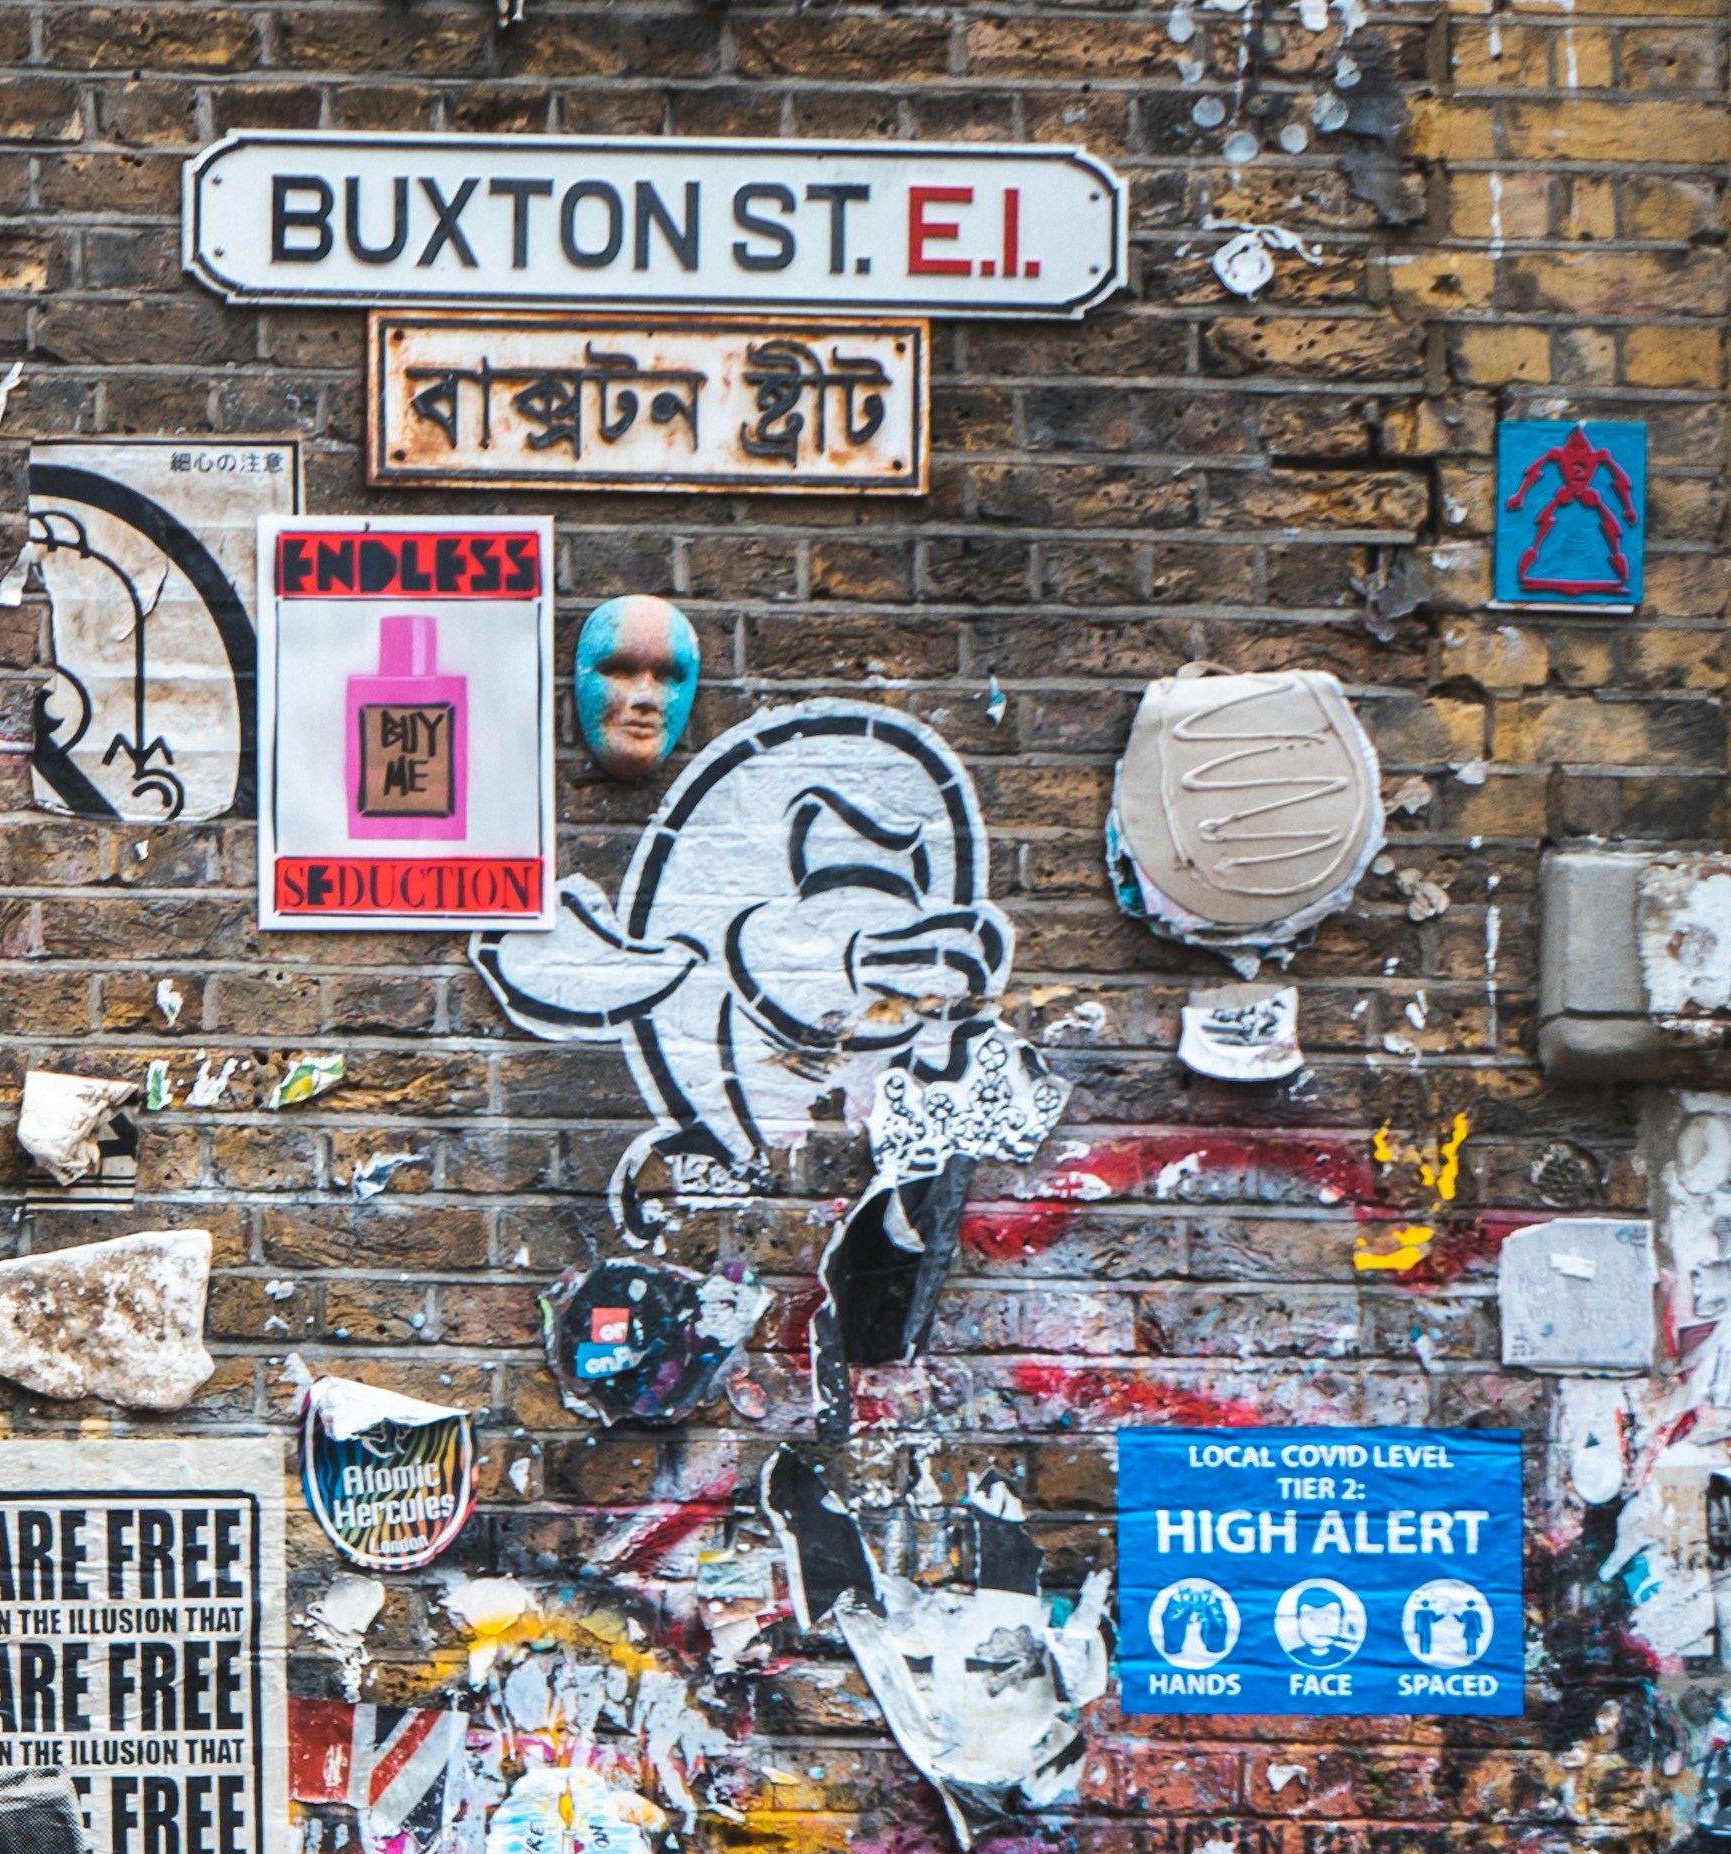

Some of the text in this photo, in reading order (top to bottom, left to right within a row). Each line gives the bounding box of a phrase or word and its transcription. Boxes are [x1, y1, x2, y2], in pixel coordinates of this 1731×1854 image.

[269, 174, 701, 271] BUXTON
[732, 181, 872, 275] ST.
[169, 451, 285, 474] 細心の注意
[282, 538, 538, 593] ENDLESS
[379, 709, 444, 758] BUY
[383, 757, 430, 796] ME
[282, 862, 533, 911] SEDUCTION
[1189, 1444, 1455, 1468] LOCAL COVID LEVEL
[342, 1457, 441, 1496] Atomic
[1276, 1477, 1367, 1500] TIER 2:
[333, 1491, 455, 1530] Hercules
[368, 1534, 430, 1555] London
[1155, 1509, 1490, 1555] HIGH ALERT
[106, 1507, 244, 1600] FREE
[17, 1608, 62, 1635] THE
[68, 1607, 178, 1634] ILLUSION
[184, 1606, 244, 1633] THAT
[108, 1640, 245, 1732] FREE
[1148, 1673, 1242, 1696] HANDS
[1289, 1673, 1353, 1696] FACE
[1397, 1673, 1499, 1697] SPACED
[18, 1740, 63, 1766] THE
[70, 1739, 179, 1765] ILLUSION
[185, 1738, 245, 1764] THAT
